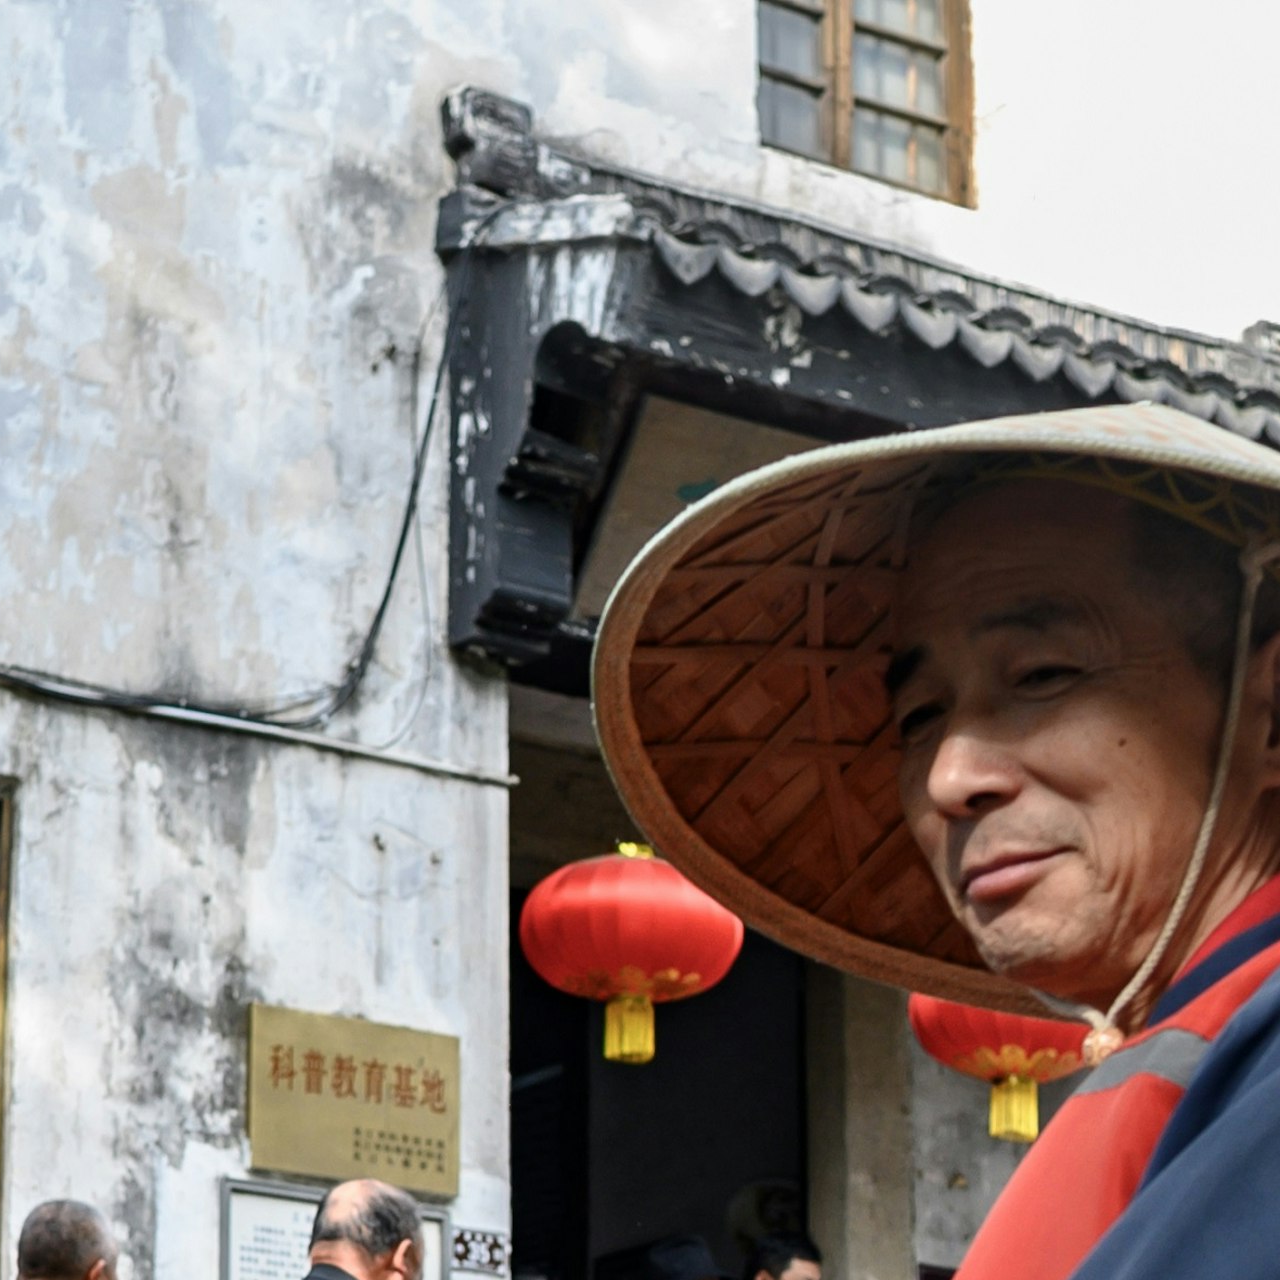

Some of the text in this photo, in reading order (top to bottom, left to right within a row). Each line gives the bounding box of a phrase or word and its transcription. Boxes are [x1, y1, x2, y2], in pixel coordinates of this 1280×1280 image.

[269, 1044, 447, 1114] 科普教育基地
